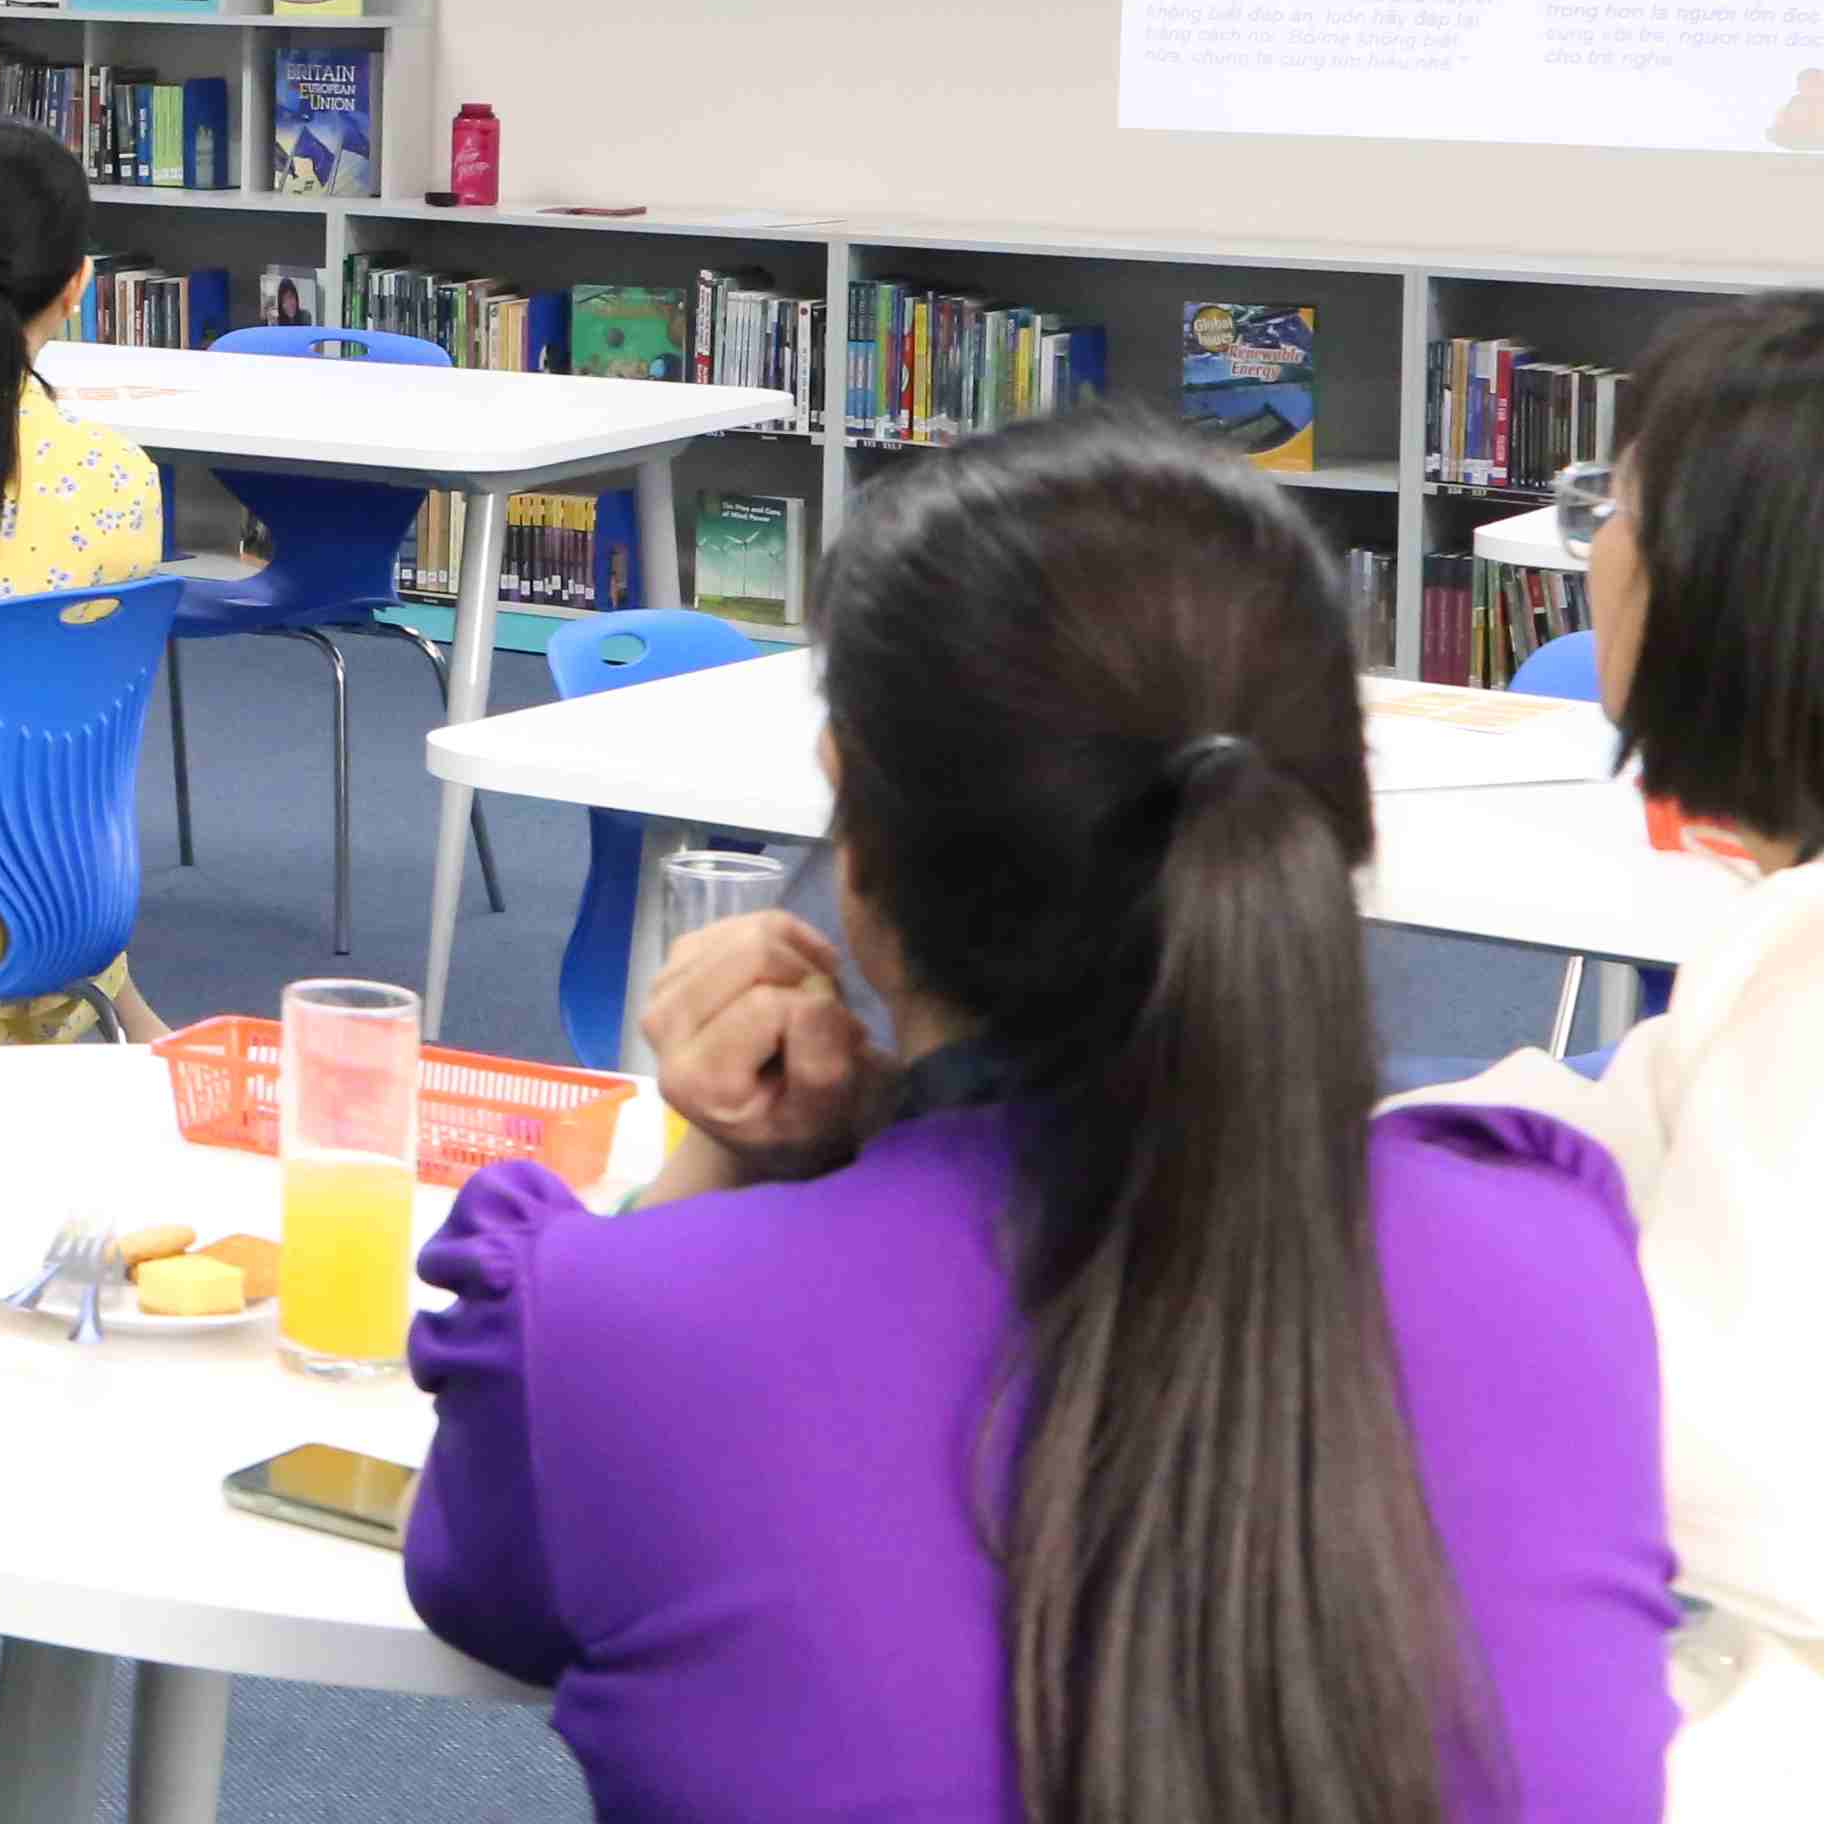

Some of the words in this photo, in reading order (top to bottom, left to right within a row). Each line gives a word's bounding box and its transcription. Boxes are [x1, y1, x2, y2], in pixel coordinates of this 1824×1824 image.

[287, 64, 355, 82] BRITAIN
[299, 83, 356, 99] EUROPEAN
[310, 94, 355, 111] UNION
[1193, 317, 1234, 333] Global
[1225, 343, 1306, 363] Renewable
[1231, 362, 1281, 382] Energy
